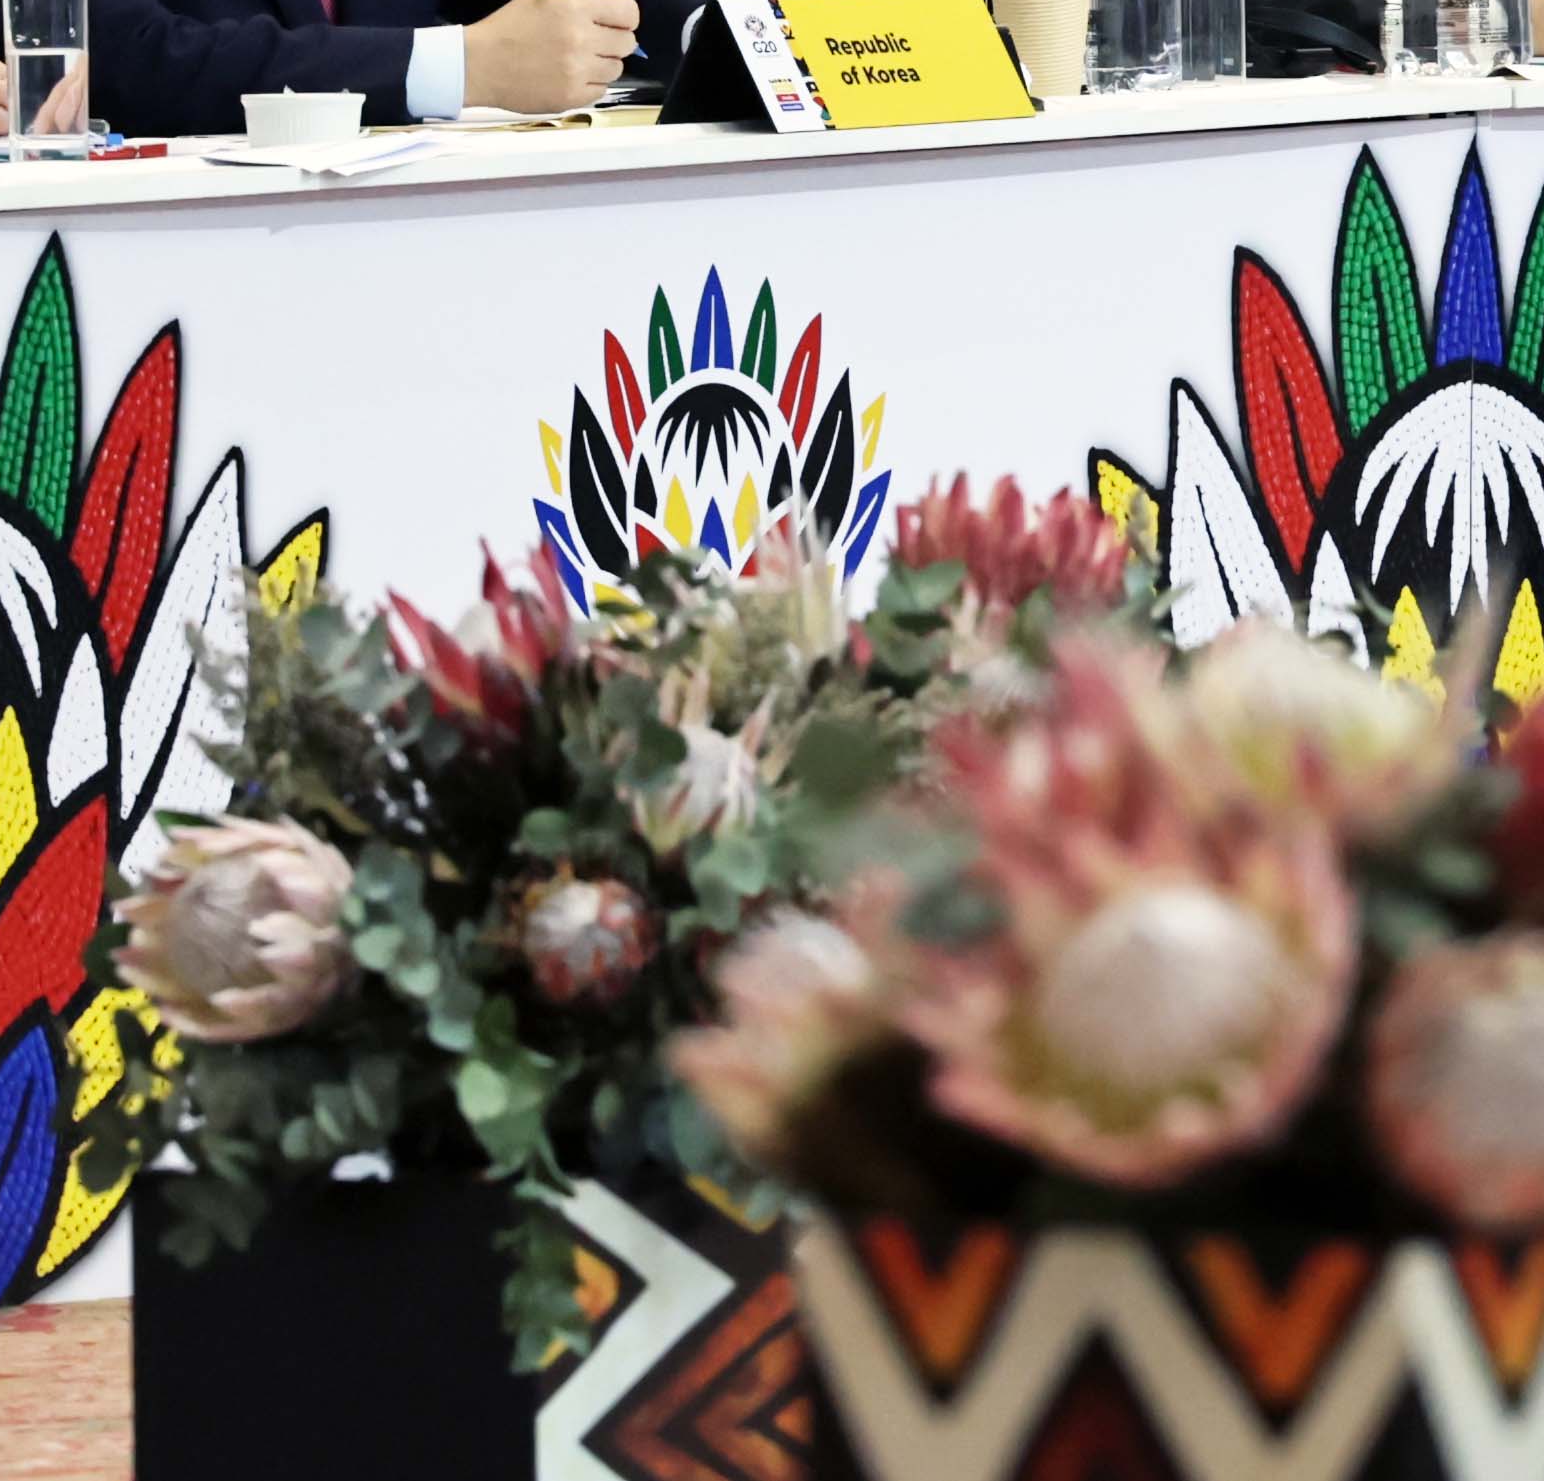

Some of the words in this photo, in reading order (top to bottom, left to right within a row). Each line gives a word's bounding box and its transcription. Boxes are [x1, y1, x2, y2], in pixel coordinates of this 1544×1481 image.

[752, 40, 778, 54] G20
[824, 32, 912, 59] Republic
[841, 66, 859, 87] of
[865, 65, 921, 85] Korea
